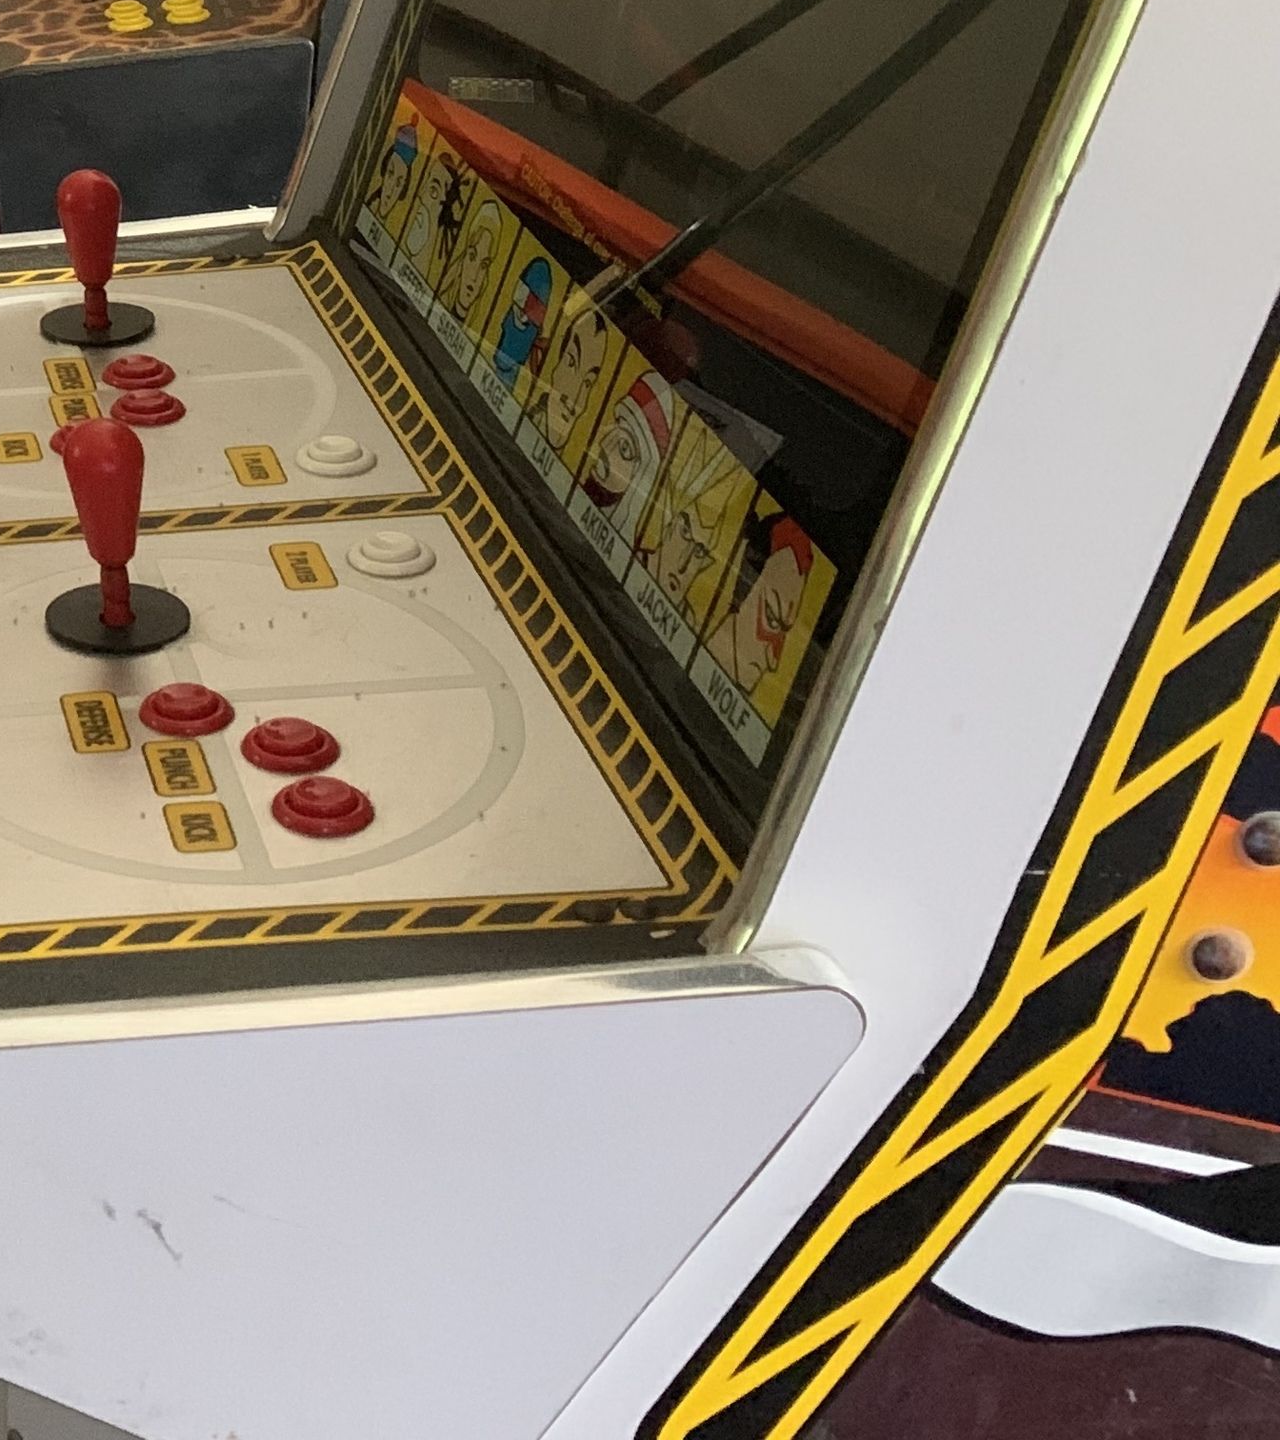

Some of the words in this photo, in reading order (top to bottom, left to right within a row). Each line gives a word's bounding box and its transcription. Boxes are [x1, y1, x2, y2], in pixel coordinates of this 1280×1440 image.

[369, 220, 381, 243] PAI
[435, 313, 466, 355] SARAH
[480, 371, 509, 414] KAGE
[532, 438, 555, 477] LAU
[580, 506, 616, 561] AKIRA
[637, 583, 680, 643] JACKY
[707, 669, 751, 730] WOLF
[74, 699, 116, 748] DEFENSE
[157, 747, 200, 791] PUNCH
[179, 812, 220, 844] KICK
